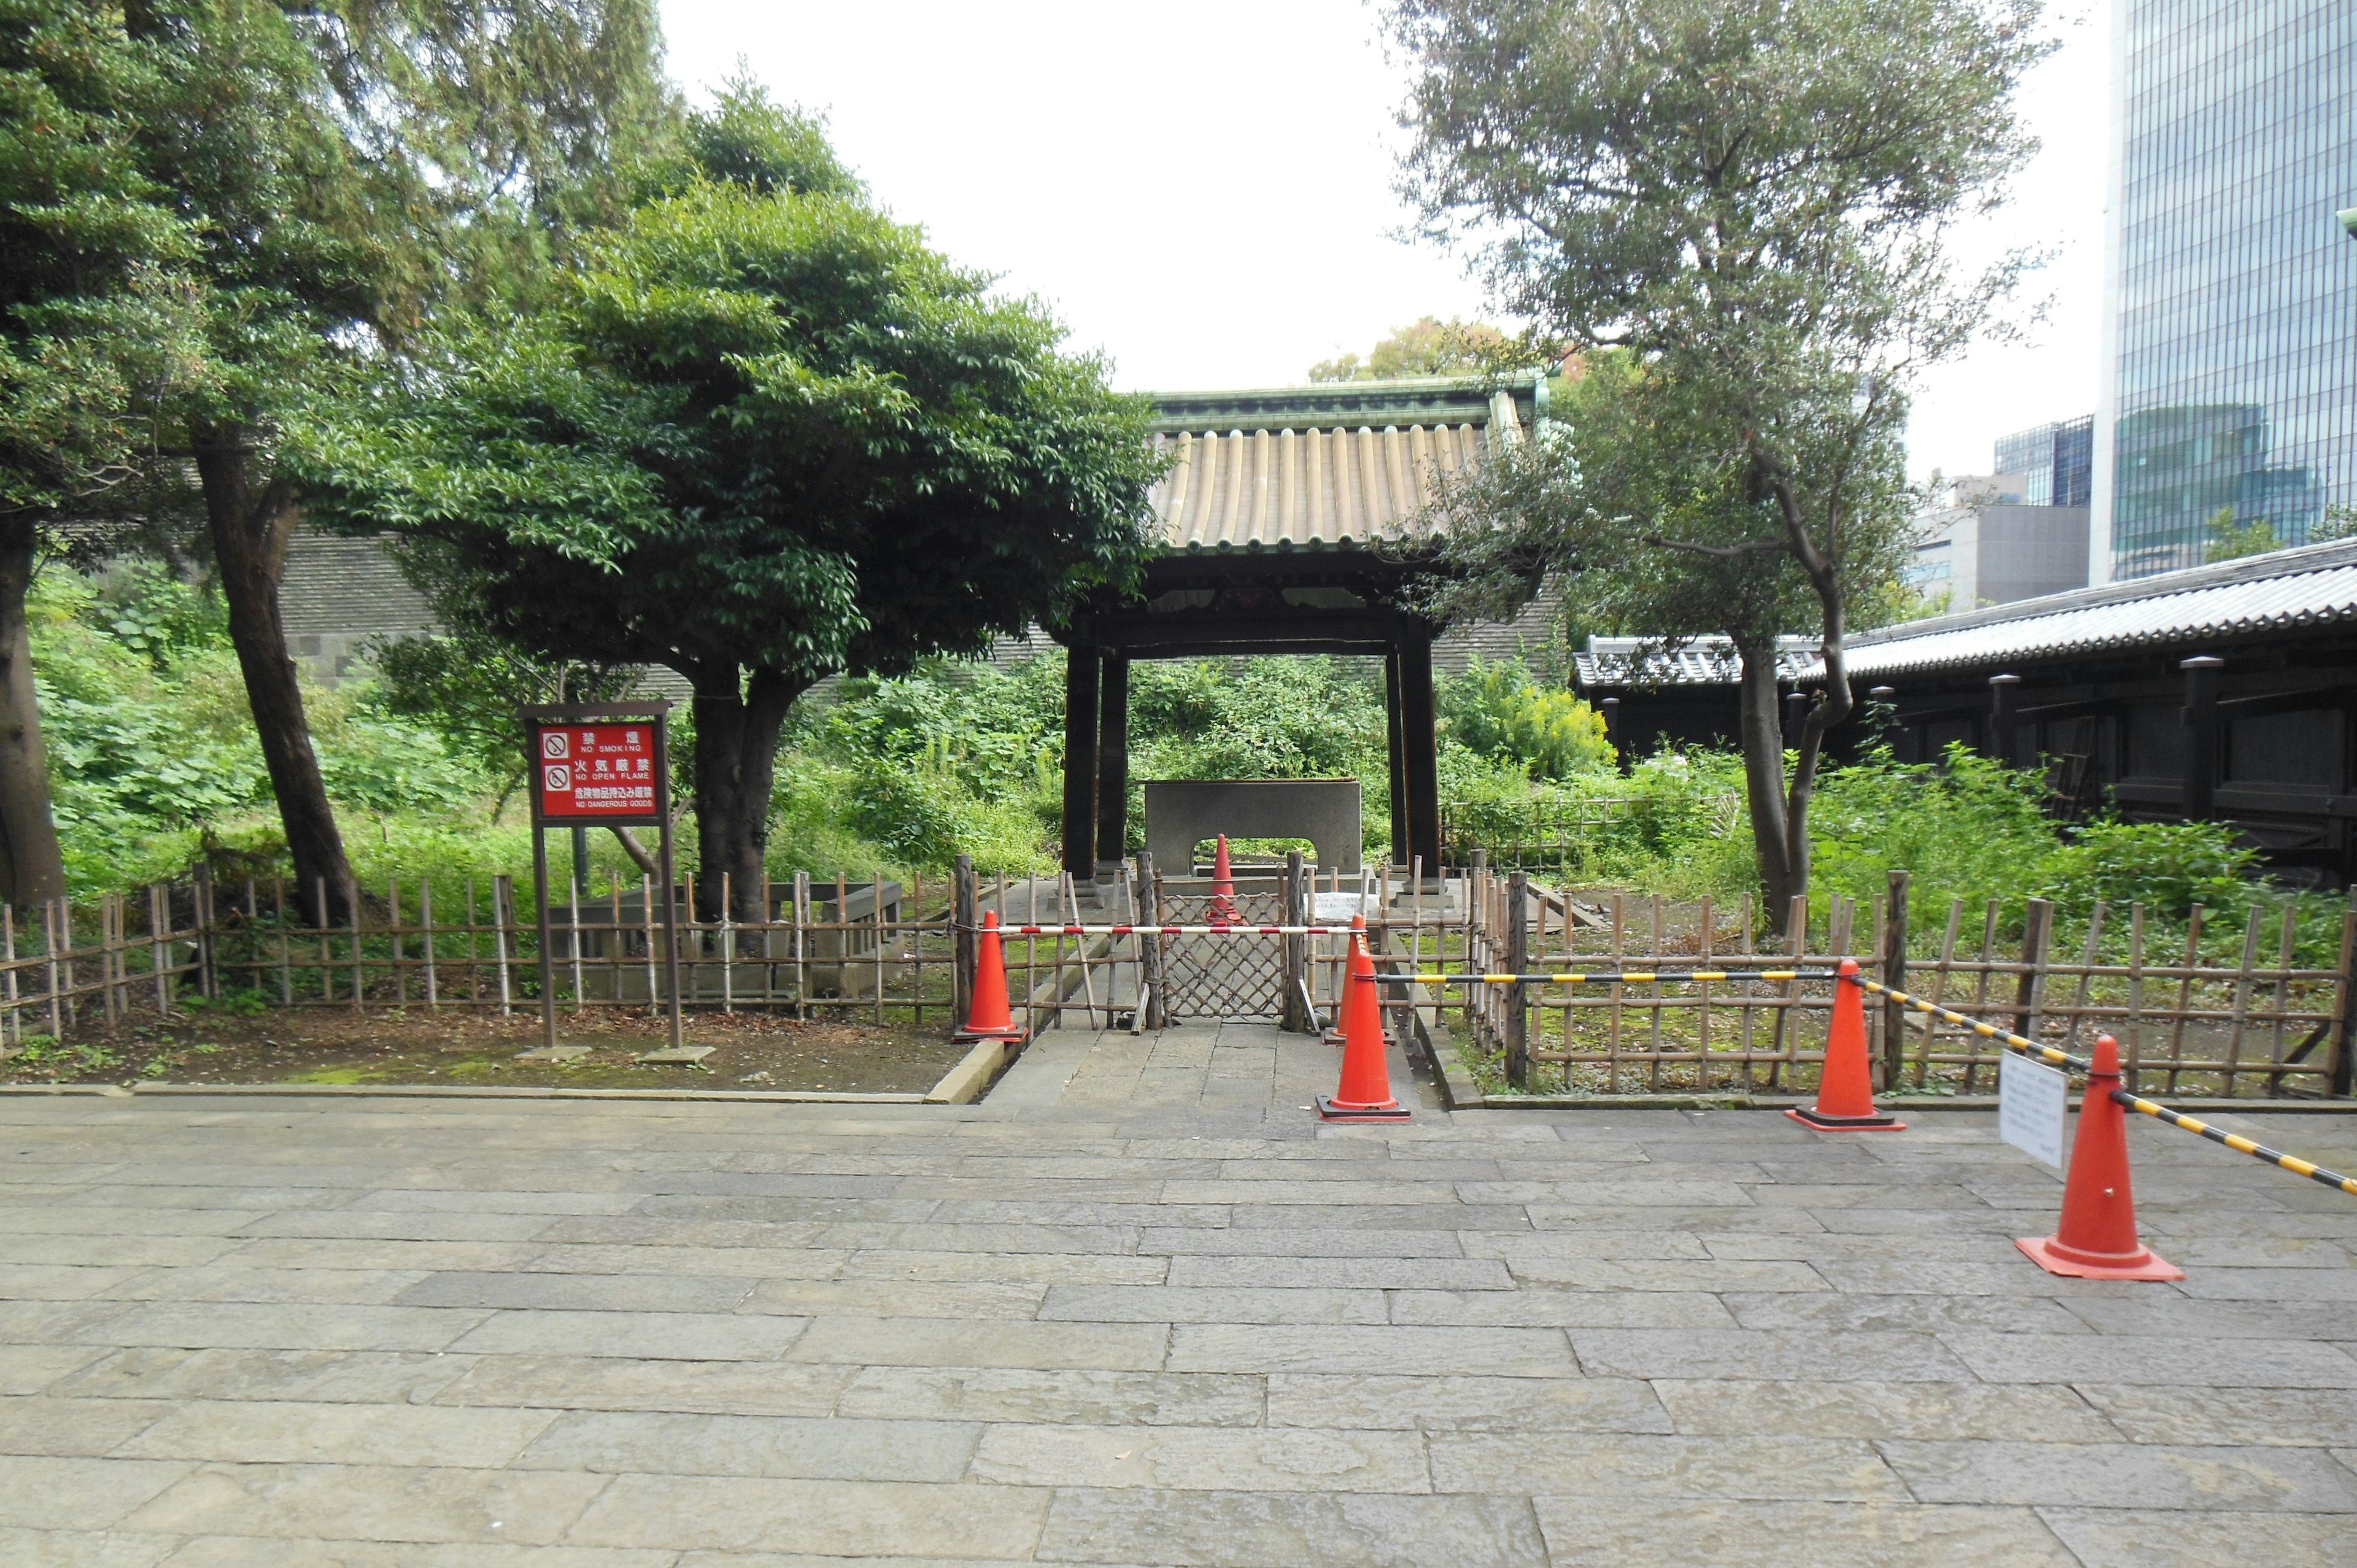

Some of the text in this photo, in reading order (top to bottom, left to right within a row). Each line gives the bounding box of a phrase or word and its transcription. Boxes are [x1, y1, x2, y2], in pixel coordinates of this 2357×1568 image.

[575, 759, 649, 772] 火気厳禁
[575, 787, 652, 798] 危険物品持込み厳禁
